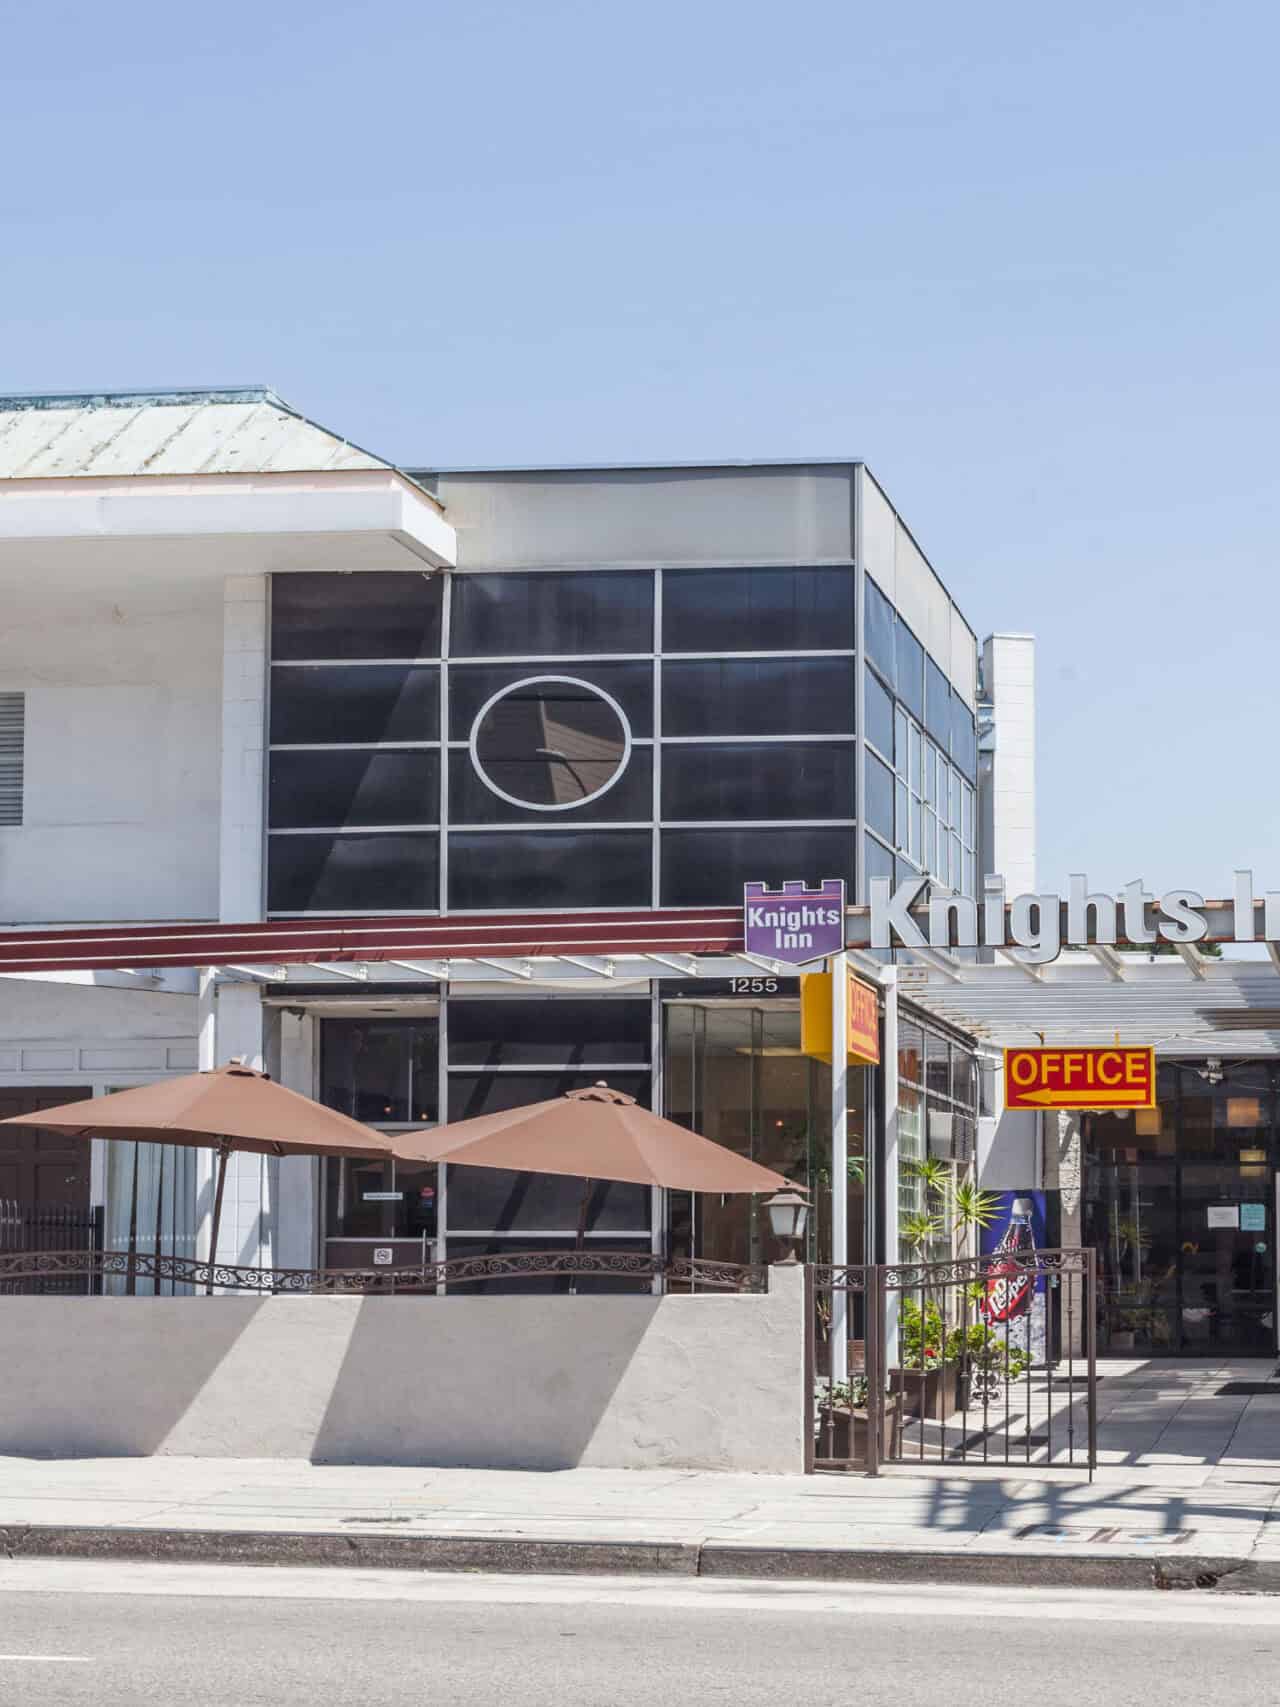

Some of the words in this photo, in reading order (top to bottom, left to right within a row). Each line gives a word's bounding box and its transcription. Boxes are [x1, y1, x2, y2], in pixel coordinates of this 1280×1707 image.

[749, 906, 840, 932] Knights
[870, 873, 1208, 964] Knights
[775, 928, 813, 950] Inn
[729, 977, 778, 993] 1255
[1011, 1052, 1147, 1086] OFFICE
